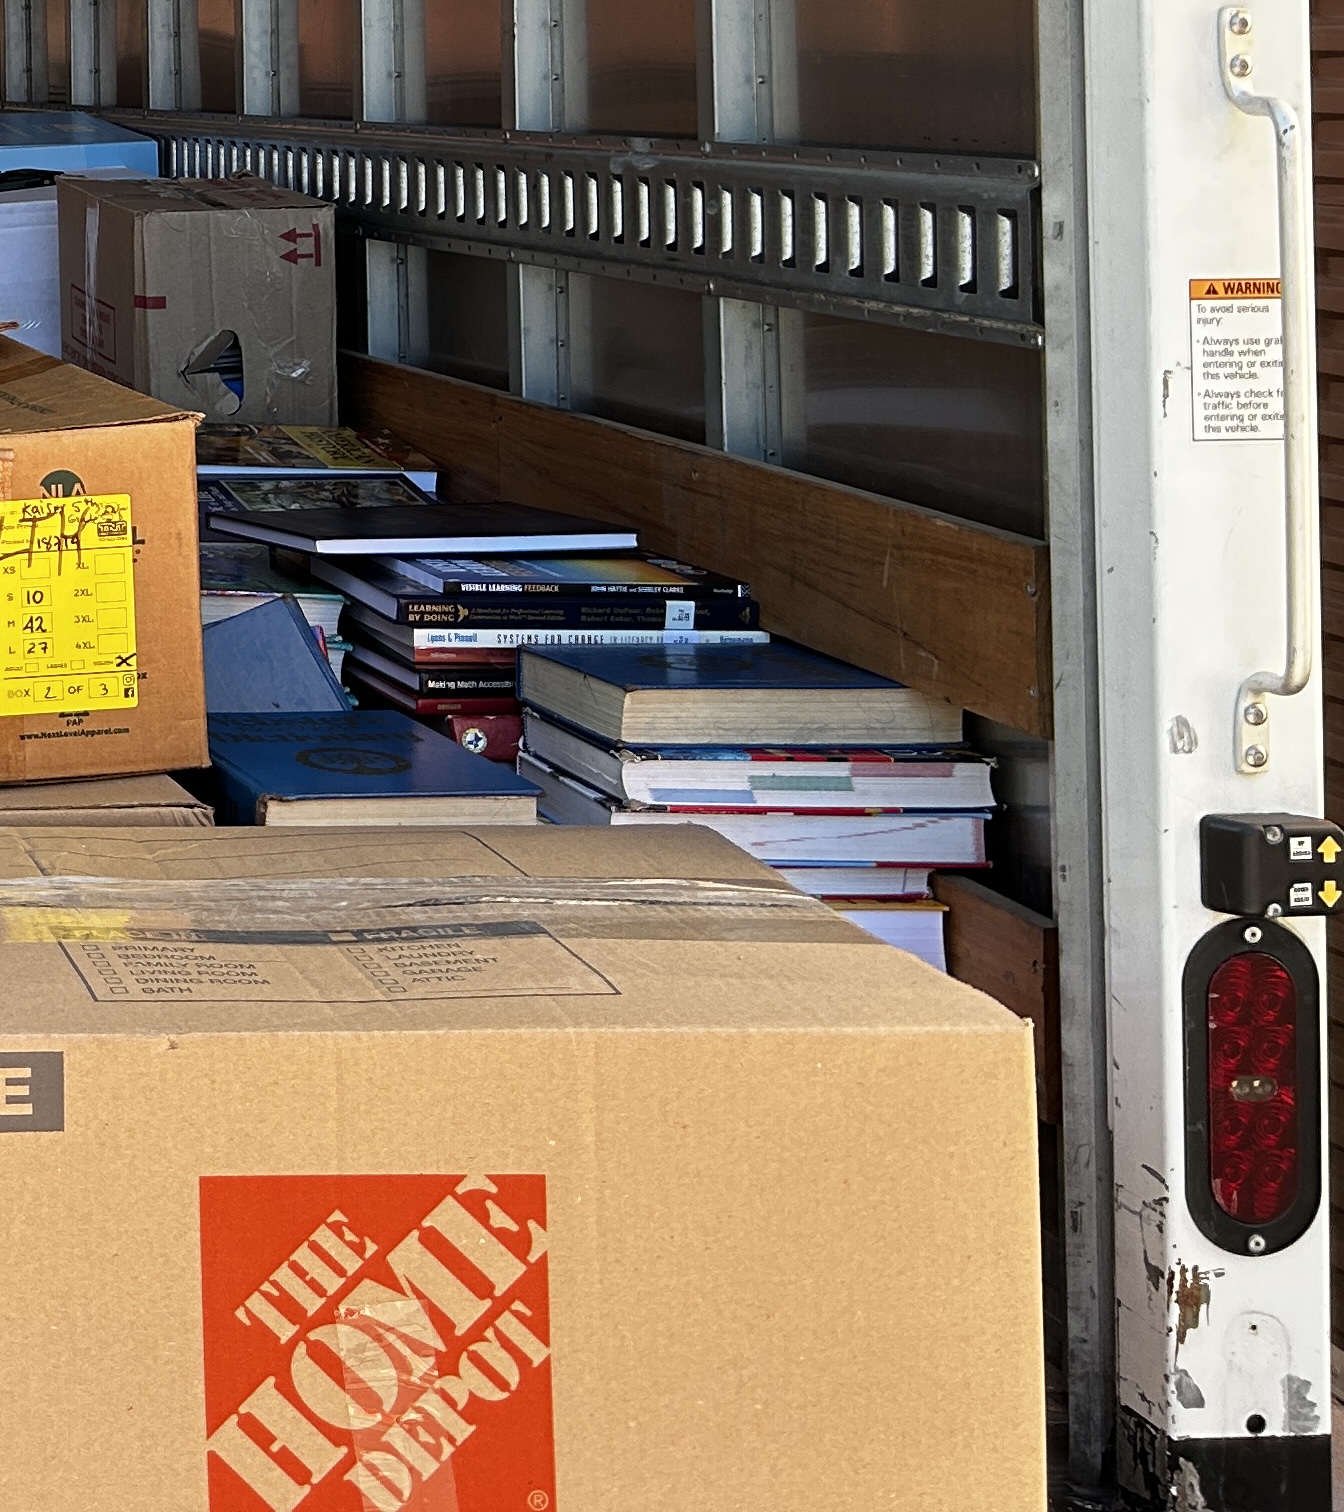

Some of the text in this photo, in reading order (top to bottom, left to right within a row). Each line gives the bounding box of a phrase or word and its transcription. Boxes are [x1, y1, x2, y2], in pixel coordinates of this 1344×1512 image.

[1196, 304, 1269, 313] To avoid serious
[1202, 336, 1239, 347] Always
[1203, 348, 1265, 357] handle when
[1203, 360, 1256, 371] entering or
[1203, 371, 1259, 381] this vehicle.
[1203, 388, 1273, 399] Always check
[1203, 400, 1268, 410] traffic before
[1204, 413, 1244, 423] entering
[1204, 424, 1260, 433] this vehicle.
[7, 593, 13, 601] S
[27, 590, 43, 604] 10
[74, 589, 93, 597] 2XL
[74, 615, 94, 623] 3XL
[497, 634, 604, 645] SYSTEMS FOR CHANGE
[9, 646, 16, 654] L
[27, 642, 48, 654] 27
[68, 685, 84, 694] OF
[99, 684, 108, 695] 3
[428, 680, 455, 689] Making
[8, 689, 30, 698] BOX
[44, 687, 57, 698] 2
[20, 727, 129, 740] www.NextLevelApparel.com
[364, 926, 482, 939] FRAGILE
[112, 945, 196, 953] PRIMARY
[376, 942, 462, 953] KITCHEN
[117, 953, 216, 961] BEDROOM
[386, 950, 475, 960] LAUNDRY
[123, 961, 257, 970] FAMILY ROOM
[394, 957, 498, 968] BASEMENT
[402, 966, 486, 975] GARAGE
[134, 977, 204, 985] DINING
[412, 975, 466, 984] ATTIC
[207, 1174, 550, 1512] THE HOME DEPOT
